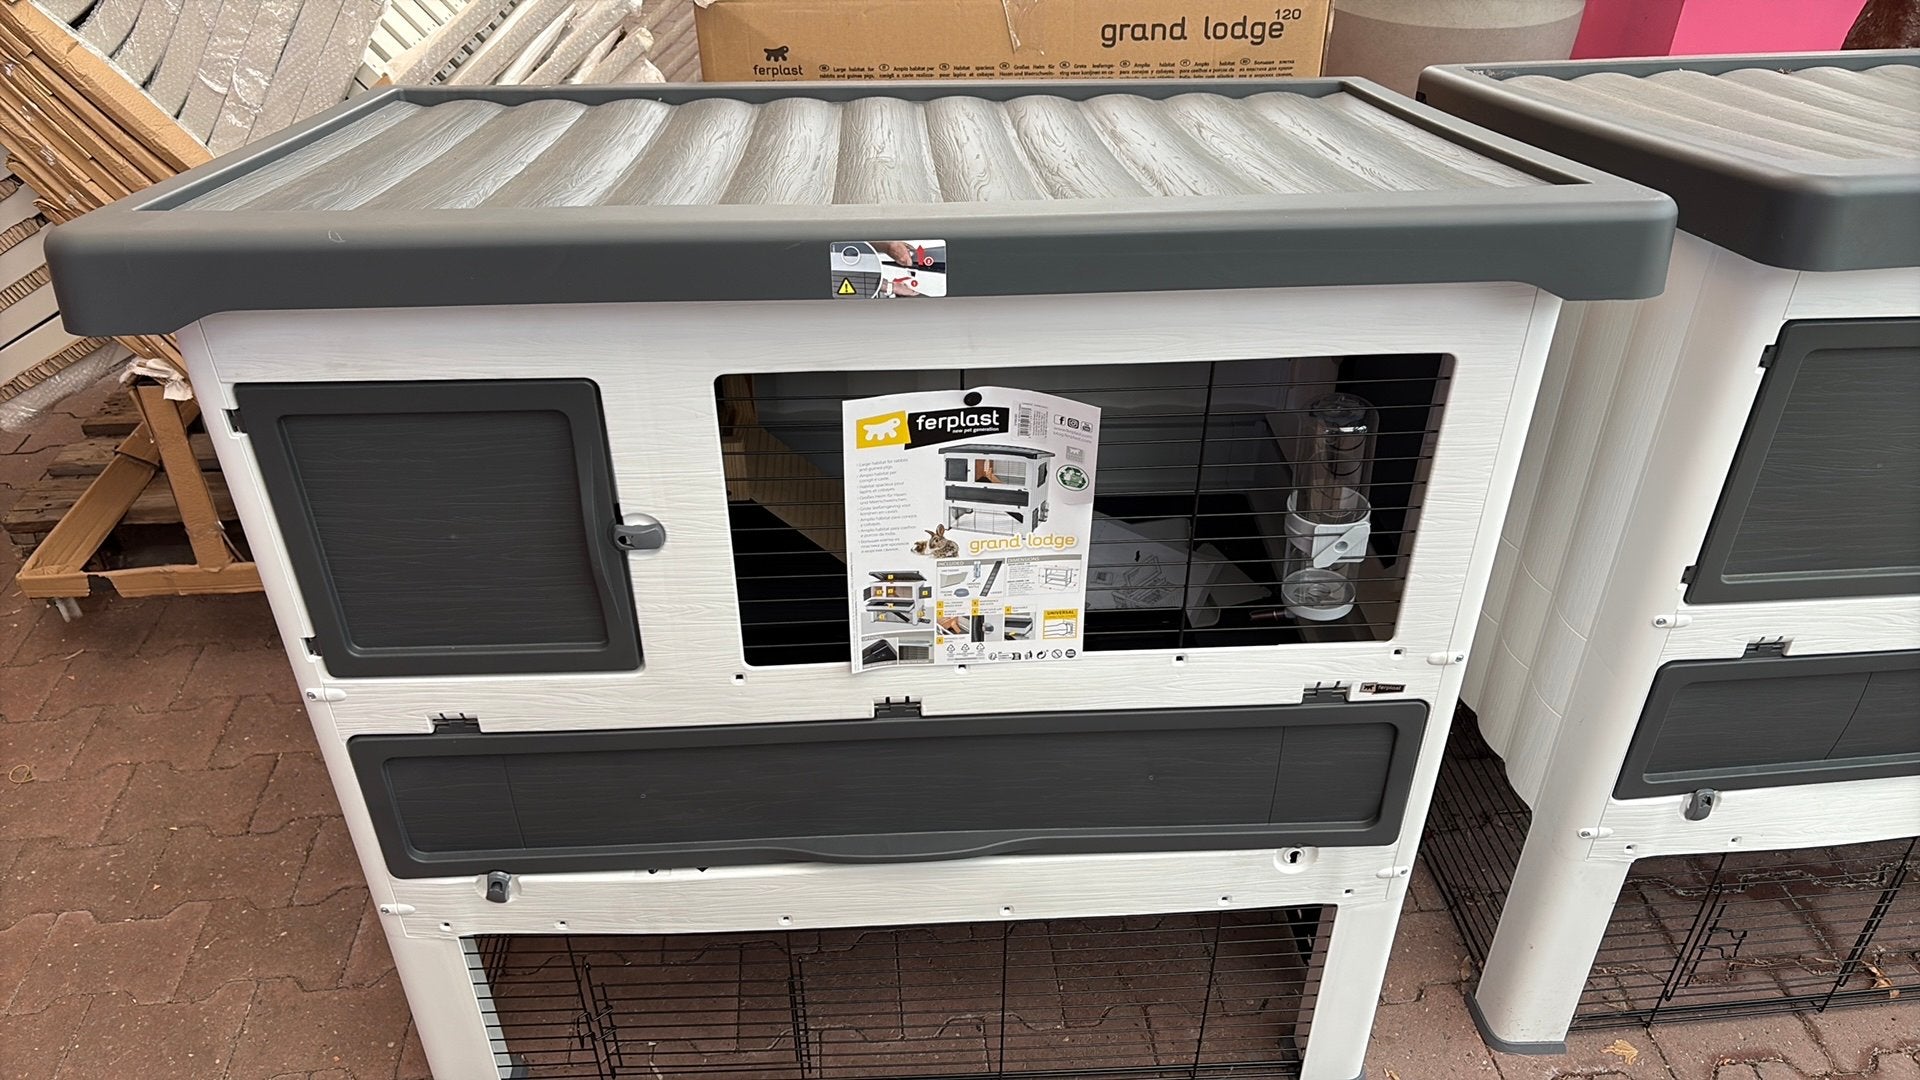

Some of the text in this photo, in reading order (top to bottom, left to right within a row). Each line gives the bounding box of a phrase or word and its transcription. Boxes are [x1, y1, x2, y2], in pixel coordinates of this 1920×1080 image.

[1101, 8, 1302, 48] grand lodge 120
[753, 64, 804, 78] ferplast
[916, 410, 1000, 432] ferplast
[970, 533, 1075, 554] grand lodge
